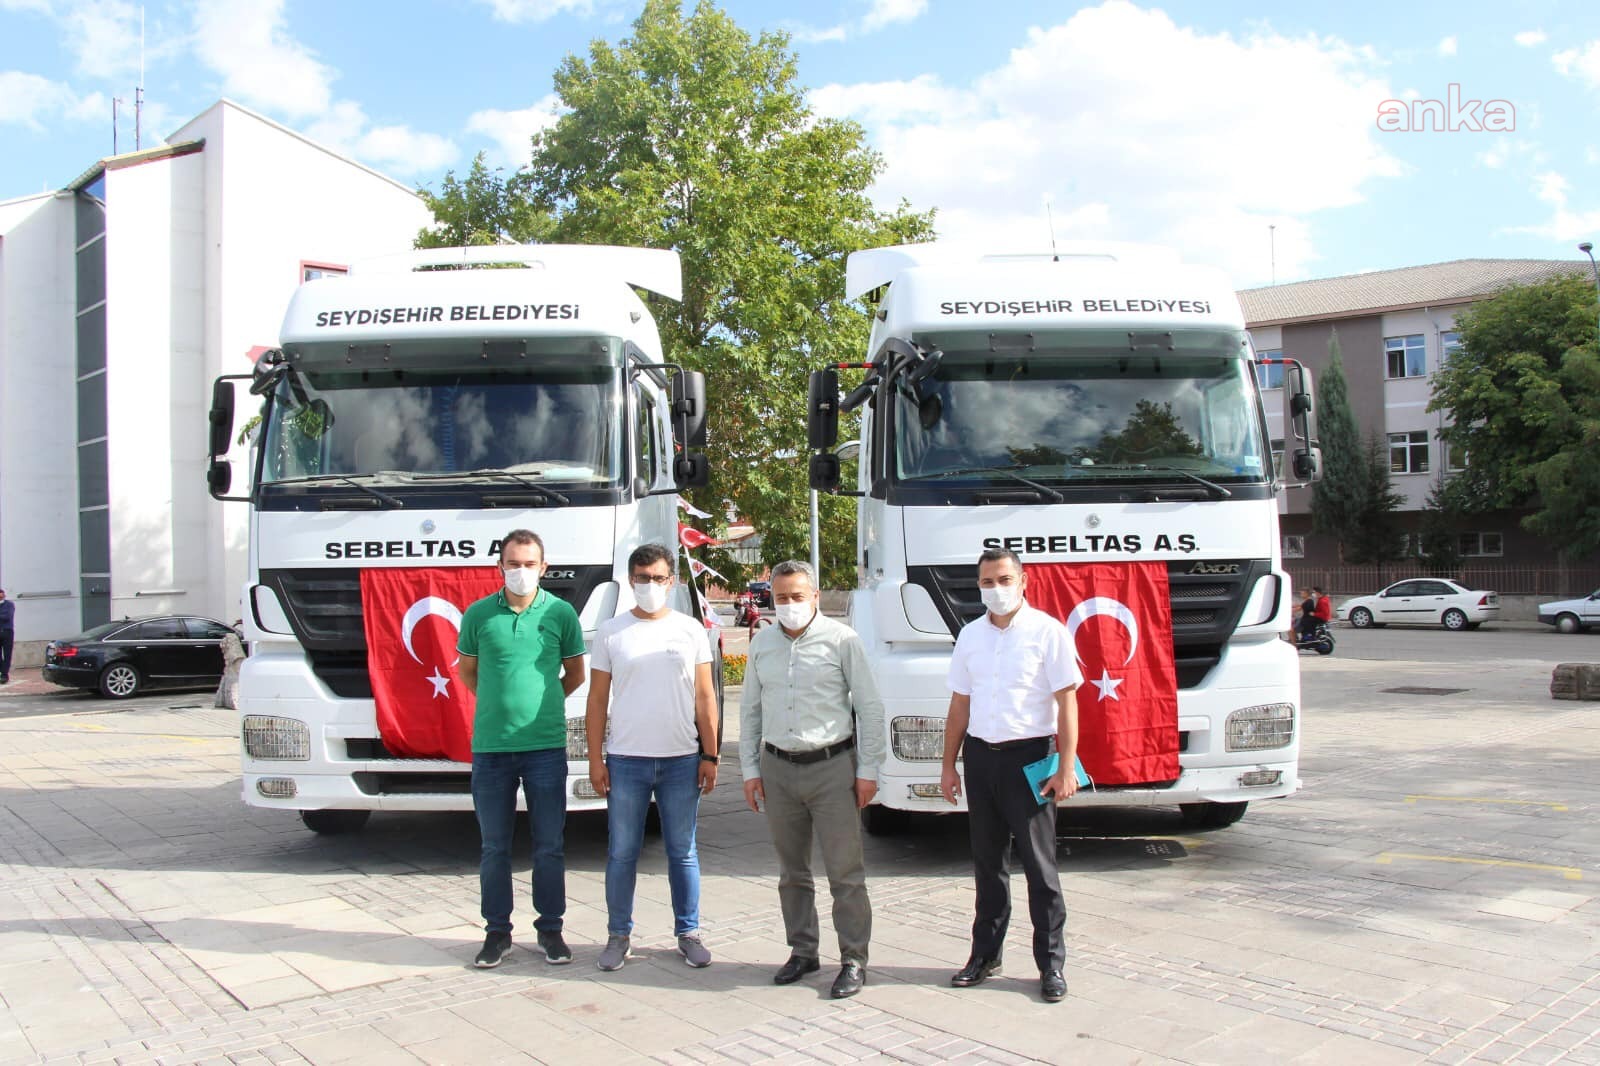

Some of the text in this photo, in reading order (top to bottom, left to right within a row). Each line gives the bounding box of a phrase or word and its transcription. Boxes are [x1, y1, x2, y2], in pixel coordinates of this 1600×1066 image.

[325, 540, 476, 559] SEBELTAŞ
[983, 534, 1201, 554] SEBELTAŞ A.Ş.
